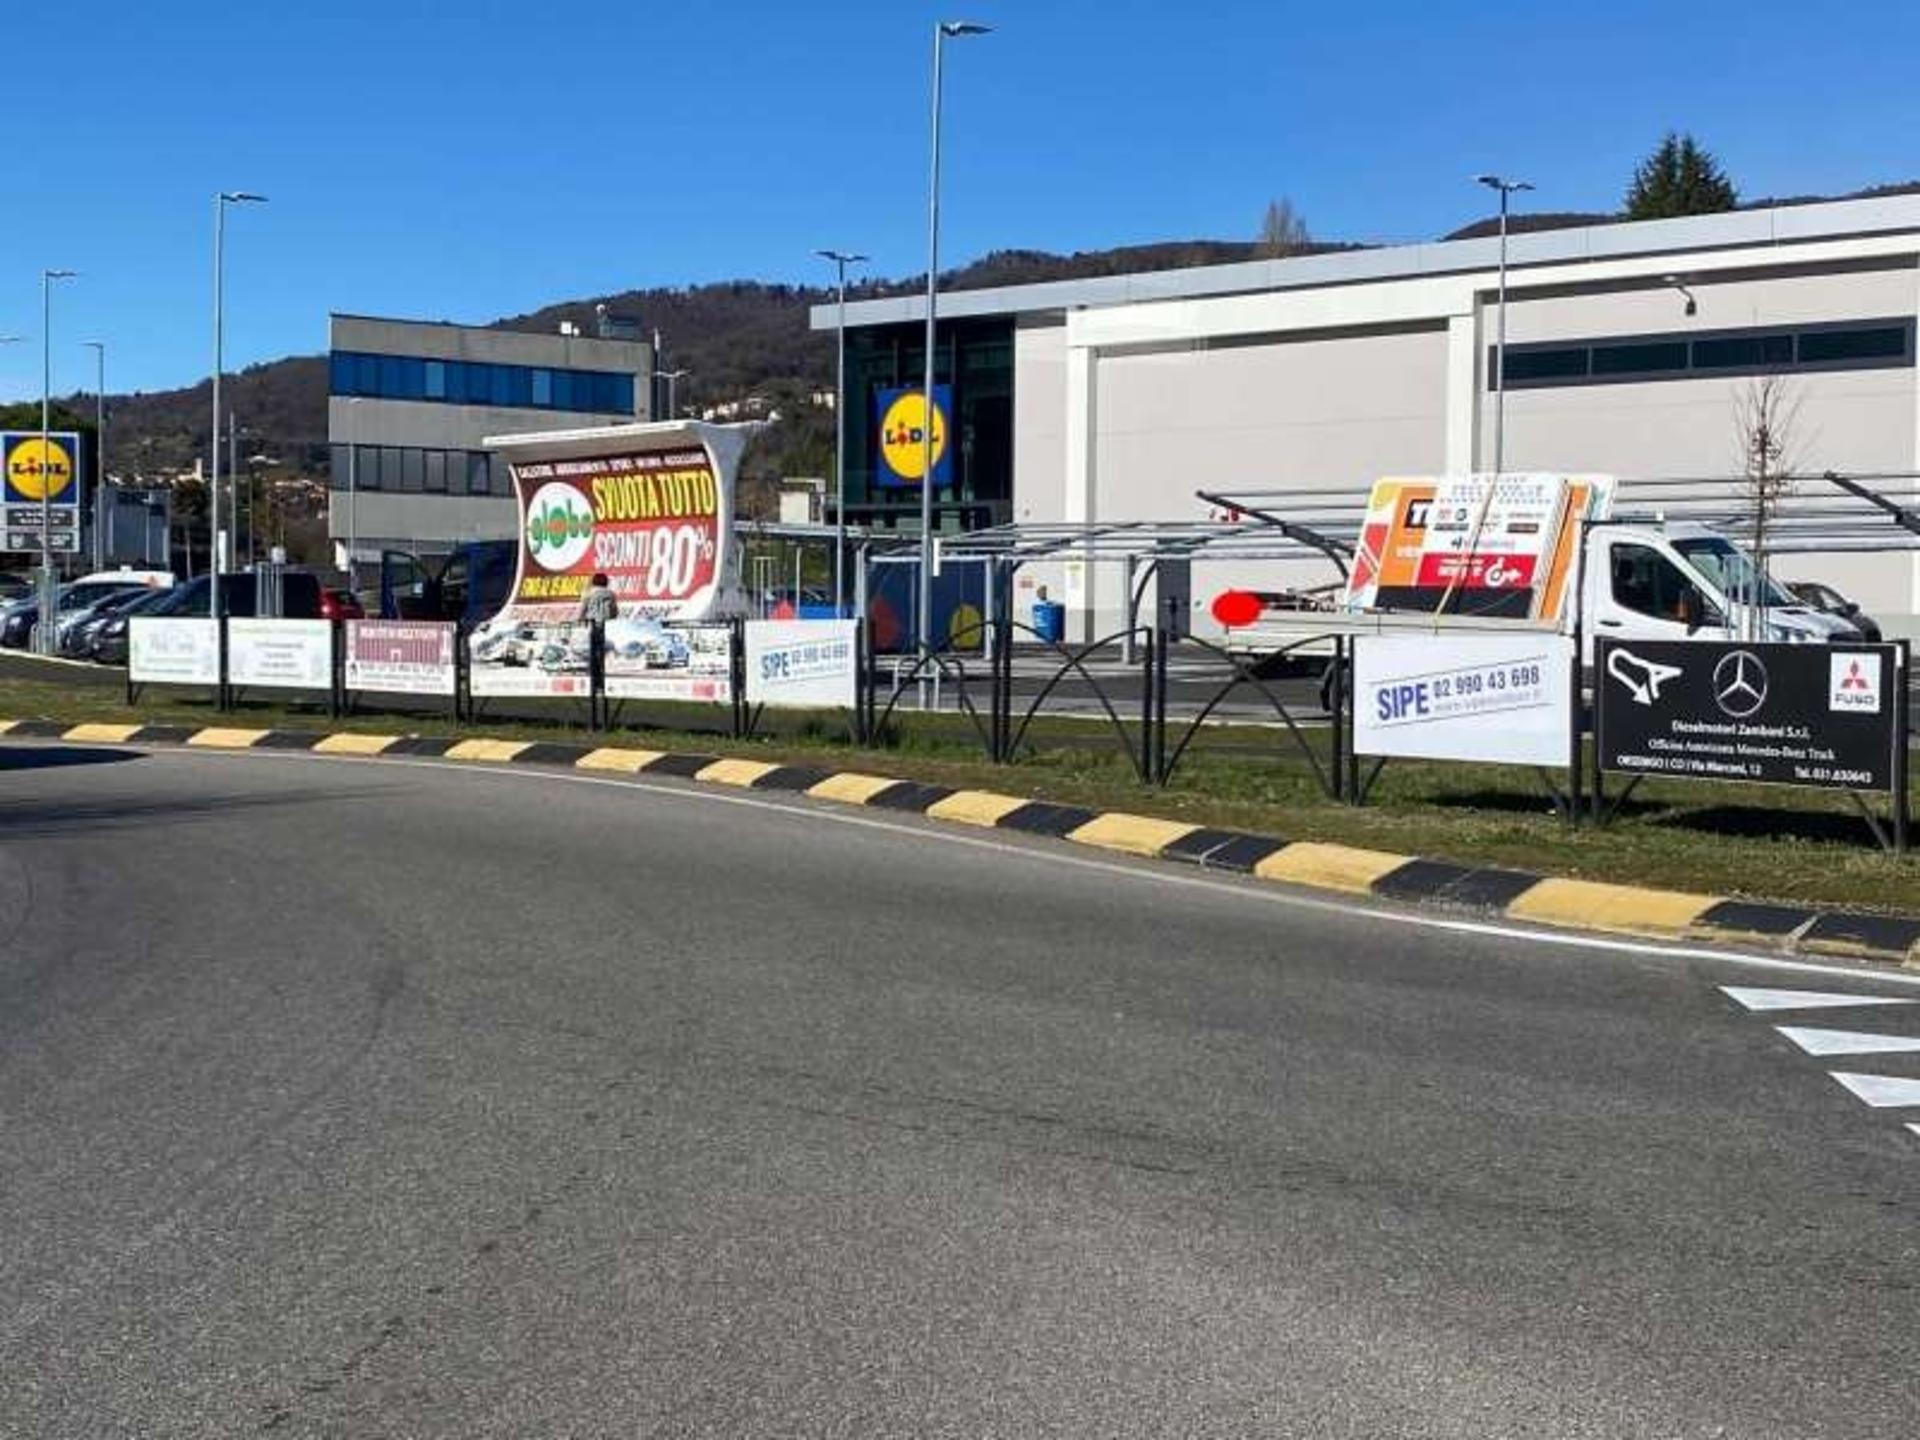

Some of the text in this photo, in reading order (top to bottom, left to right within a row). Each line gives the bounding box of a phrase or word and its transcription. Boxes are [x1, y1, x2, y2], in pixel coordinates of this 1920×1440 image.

[591, 469, 715, 521] SVUOTA TUTTO
[594, 530, 651, 569] SCONTI
[1377, 683, 1429, 721] SIPE
[1433, 679, 1451, 699] 02
[1487, 671, 1506, 690] 43
[1511, 665, 1540, 687] 698
